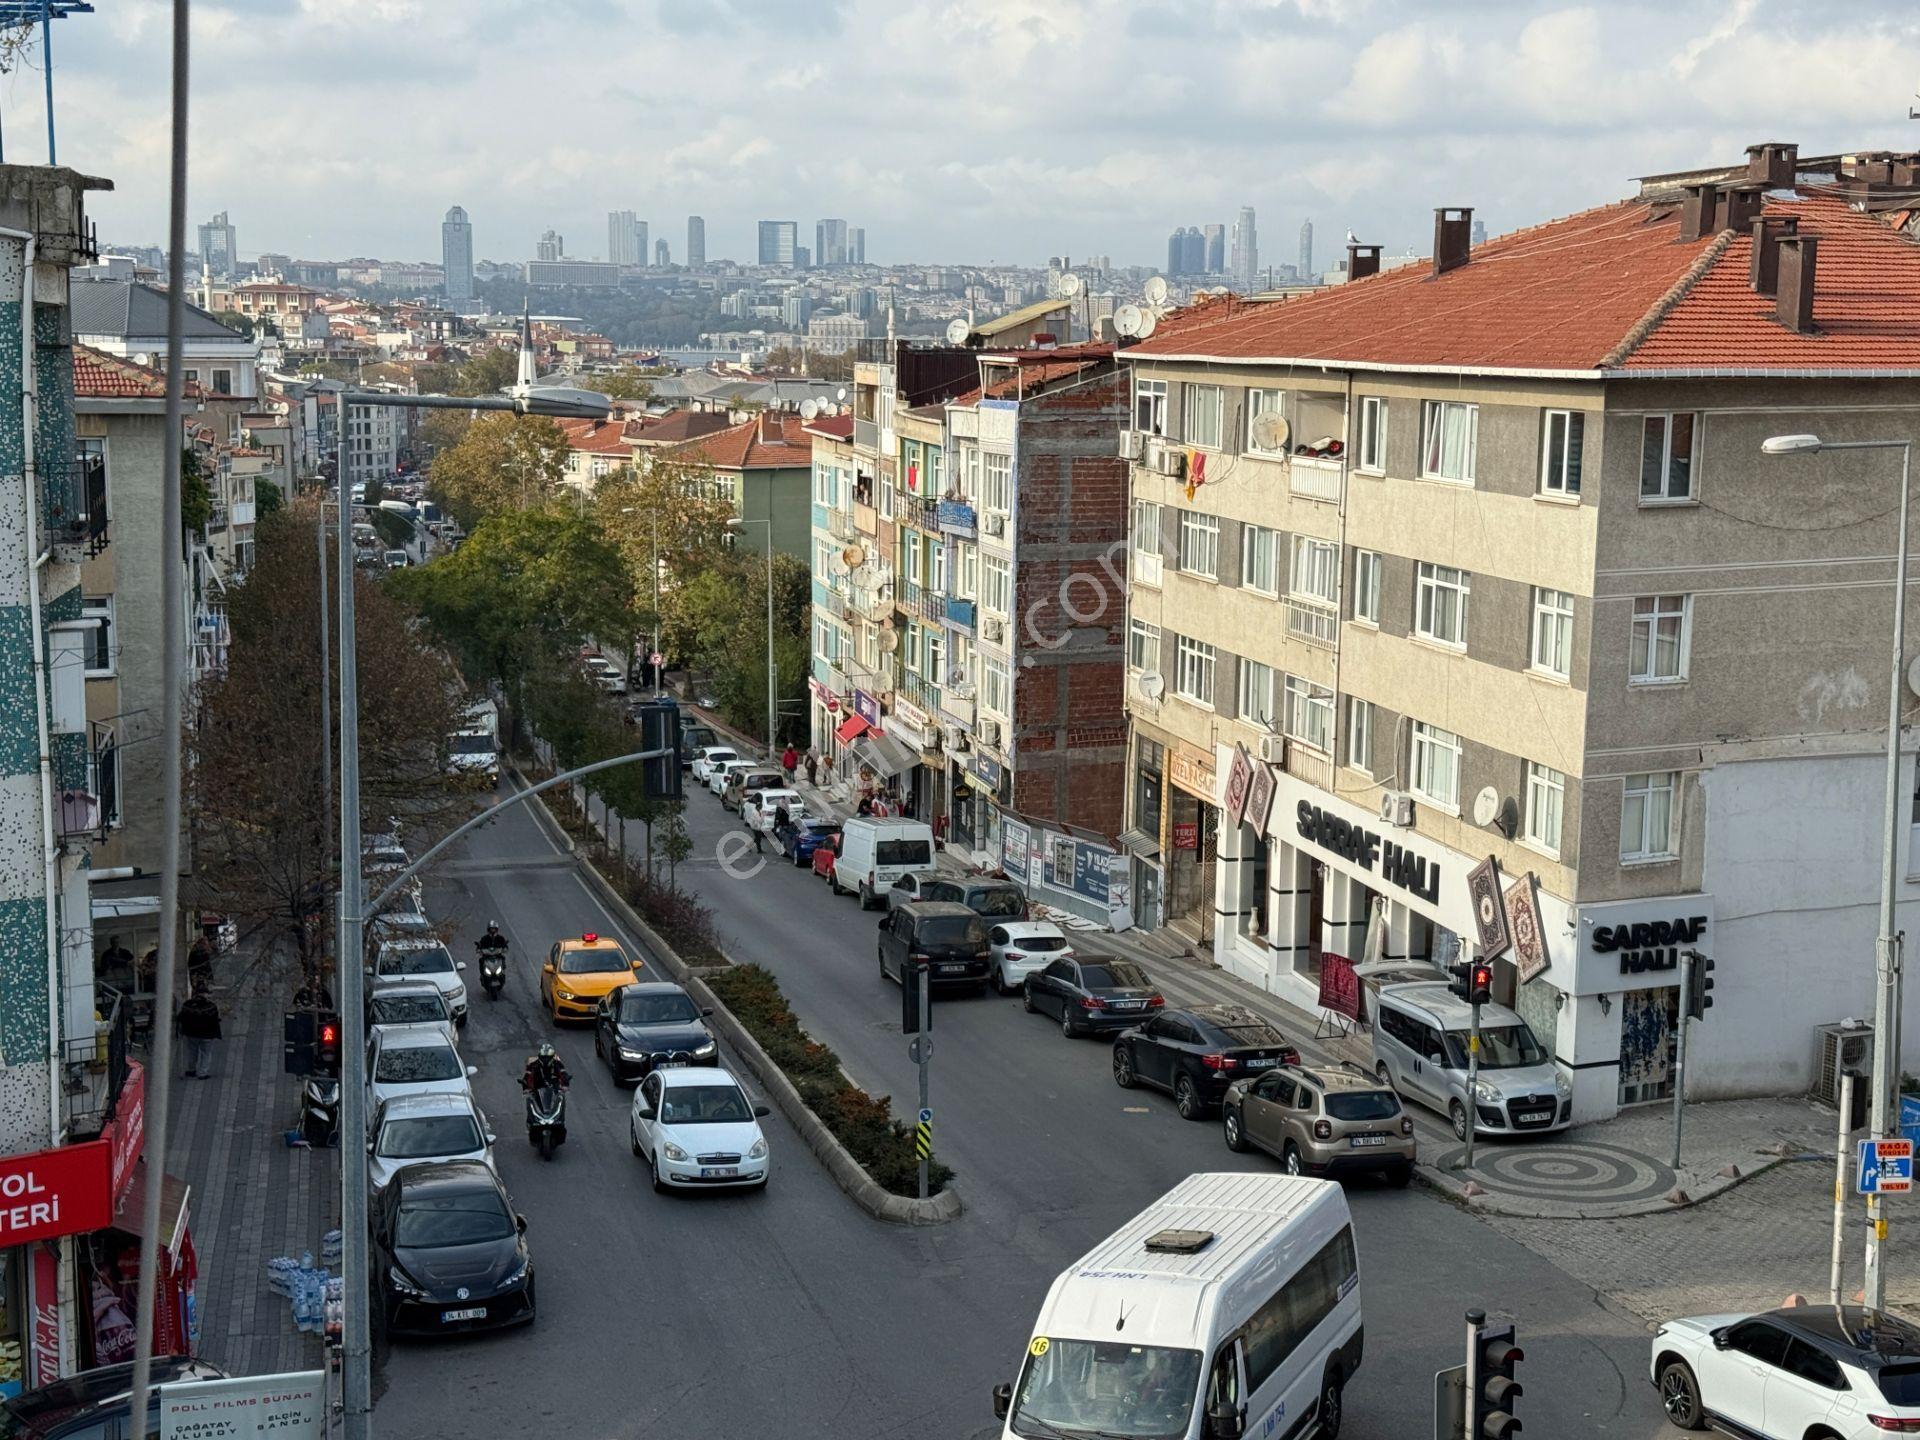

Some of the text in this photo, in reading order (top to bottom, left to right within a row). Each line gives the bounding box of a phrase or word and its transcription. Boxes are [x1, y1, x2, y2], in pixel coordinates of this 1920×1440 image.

[1296, 799, 1441, 906] SARRAF HALI
[1592, 916, 1708, 953] SARRAF
[1620, 947, 1678, 974] HALI
[0, 1171, 45, 1198] OL
[1033, 1341, 1048, 1353] 16
[171, 1392, 313, 1414] POLL FILMS SUNAR
